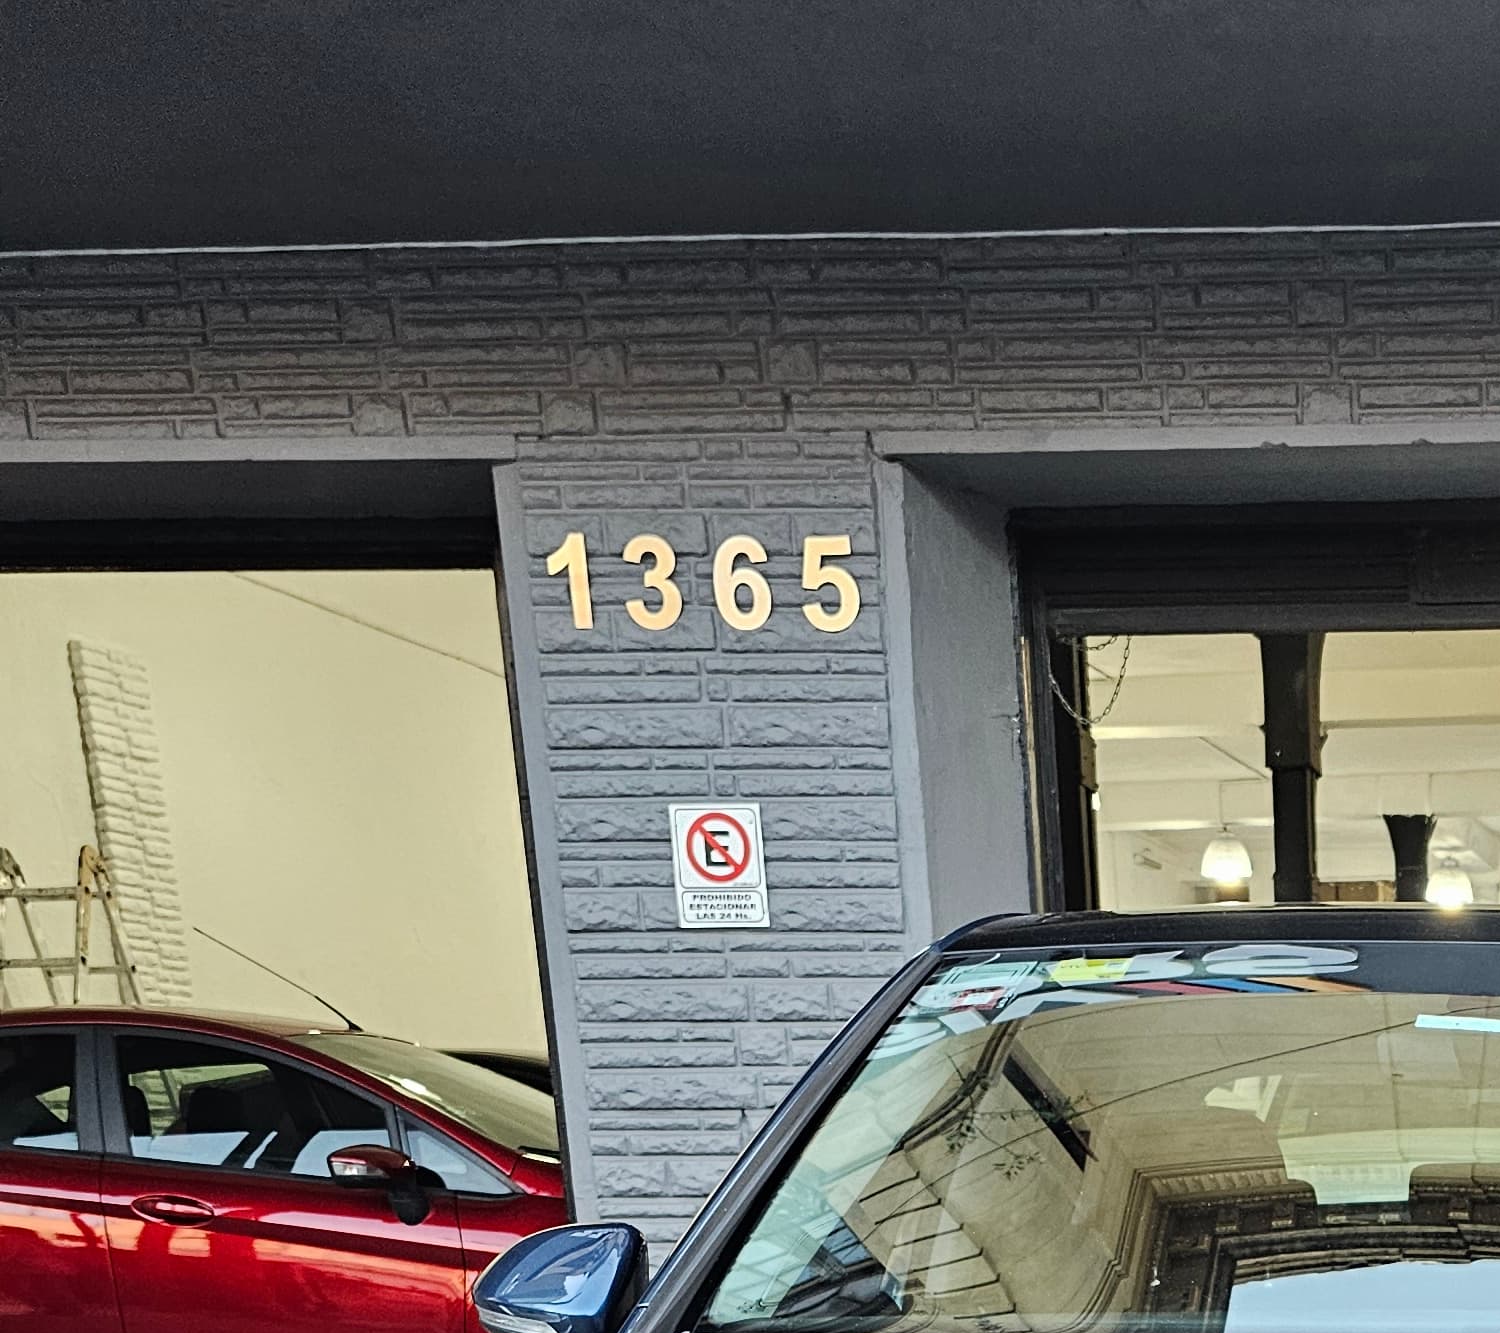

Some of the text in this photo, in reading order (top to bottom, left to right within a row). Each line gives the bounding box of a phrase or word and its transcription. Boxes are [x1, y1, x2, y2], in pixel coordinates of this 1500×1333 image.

[546, 532, 861, 633] 1365
[704, 831, 731, 866] E
[696, 912, 716, 920] LAS
[719, 912, 732, 920] 24
